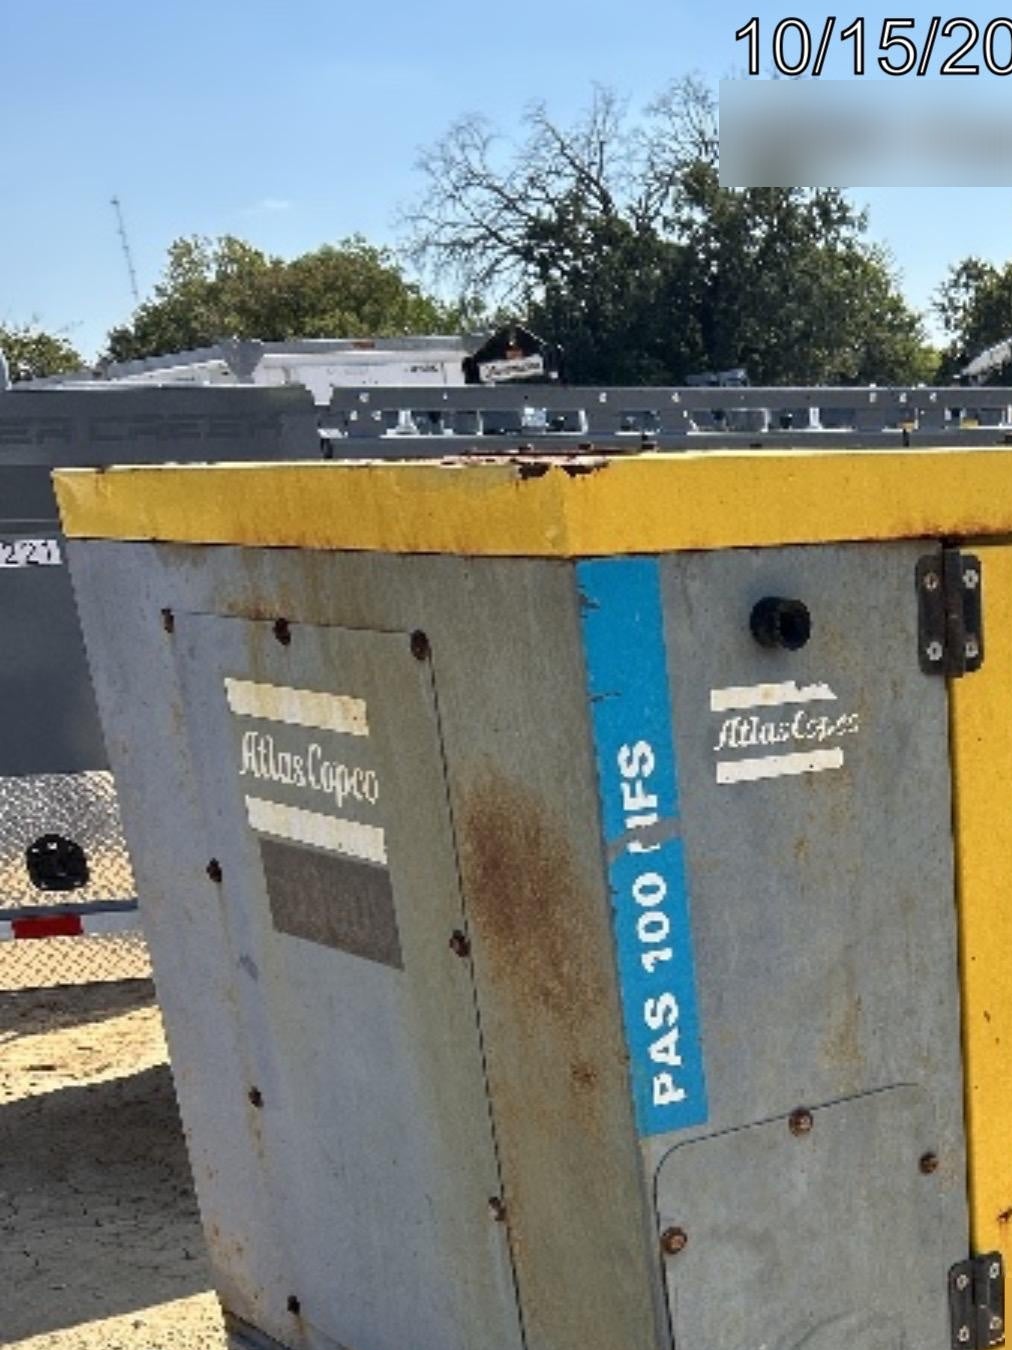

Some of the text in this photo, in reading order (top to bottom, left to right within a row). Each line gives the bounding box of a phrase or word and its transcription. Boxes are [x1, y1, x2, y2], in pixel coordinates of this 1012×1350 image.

[239, 731, 380, 809] Atlas Copco
[632, 871, 674, 974] 100
[644, 991, 688, 1107] PAS
